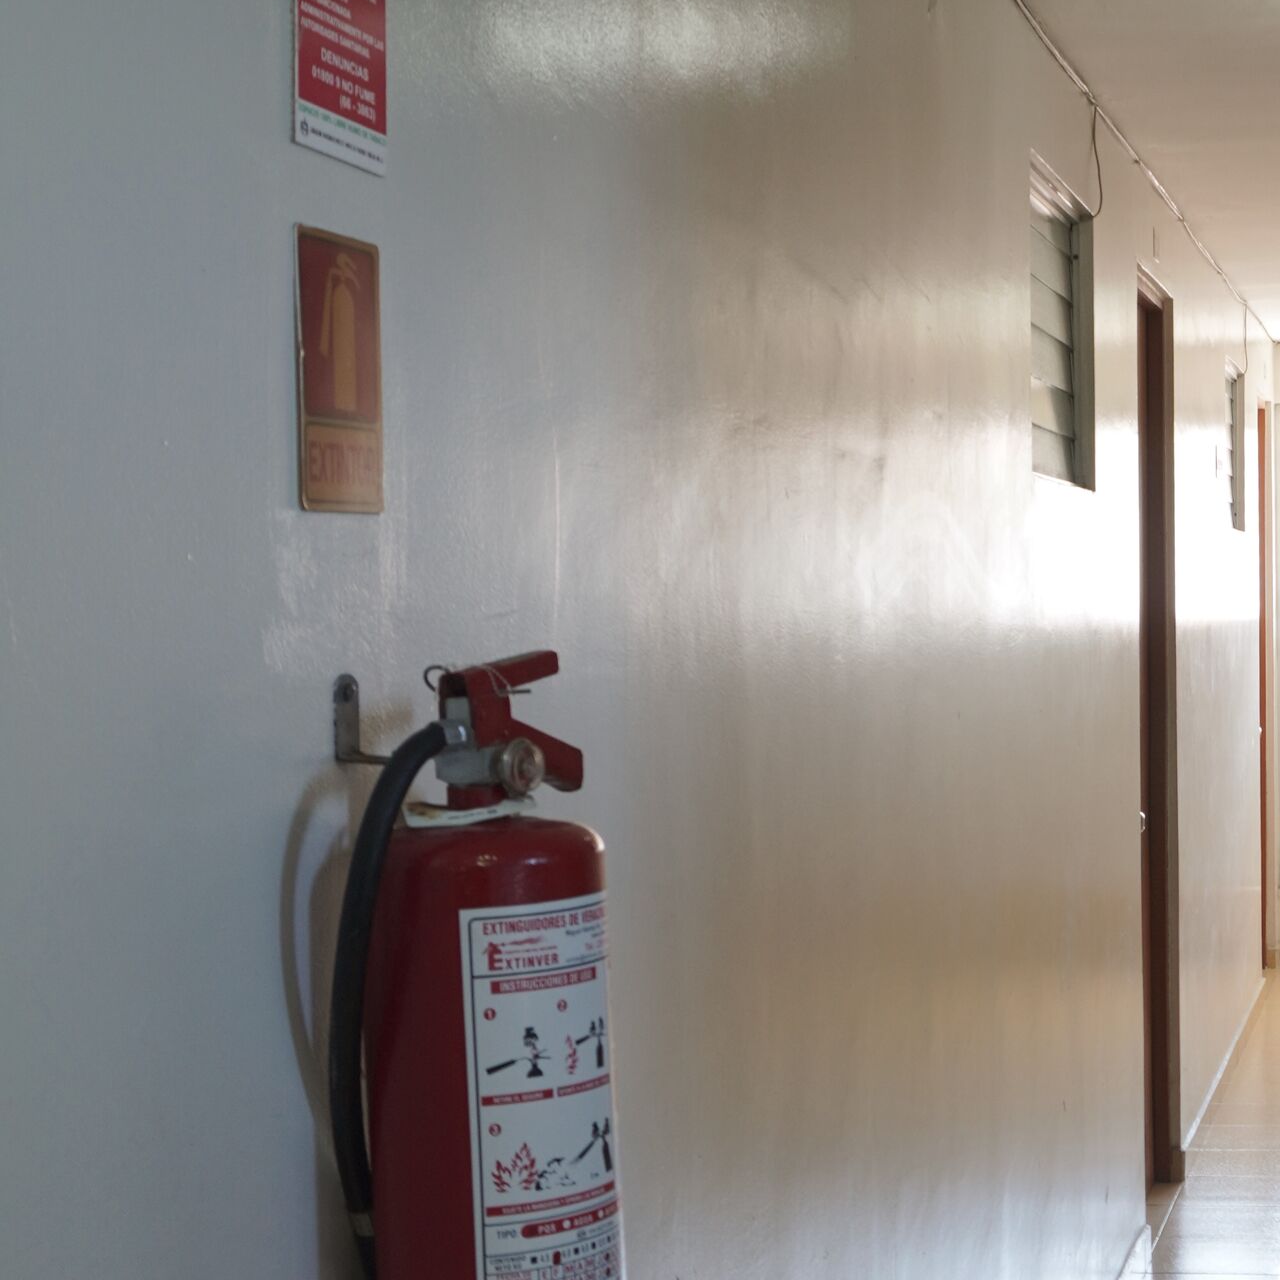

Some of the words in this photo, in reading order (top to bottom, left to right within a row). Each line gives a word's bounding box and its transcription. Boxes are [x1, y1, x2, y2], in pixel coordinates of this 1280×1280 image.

[321, 47, 369, 82] DENUNCIAS
[341, 79, 354, 94] NO
[354, 83, 376, 105] FUME
[487, 944, 559, 971] EXTINVER
[500, 972, 568, 992] INSTRUCCIONES
